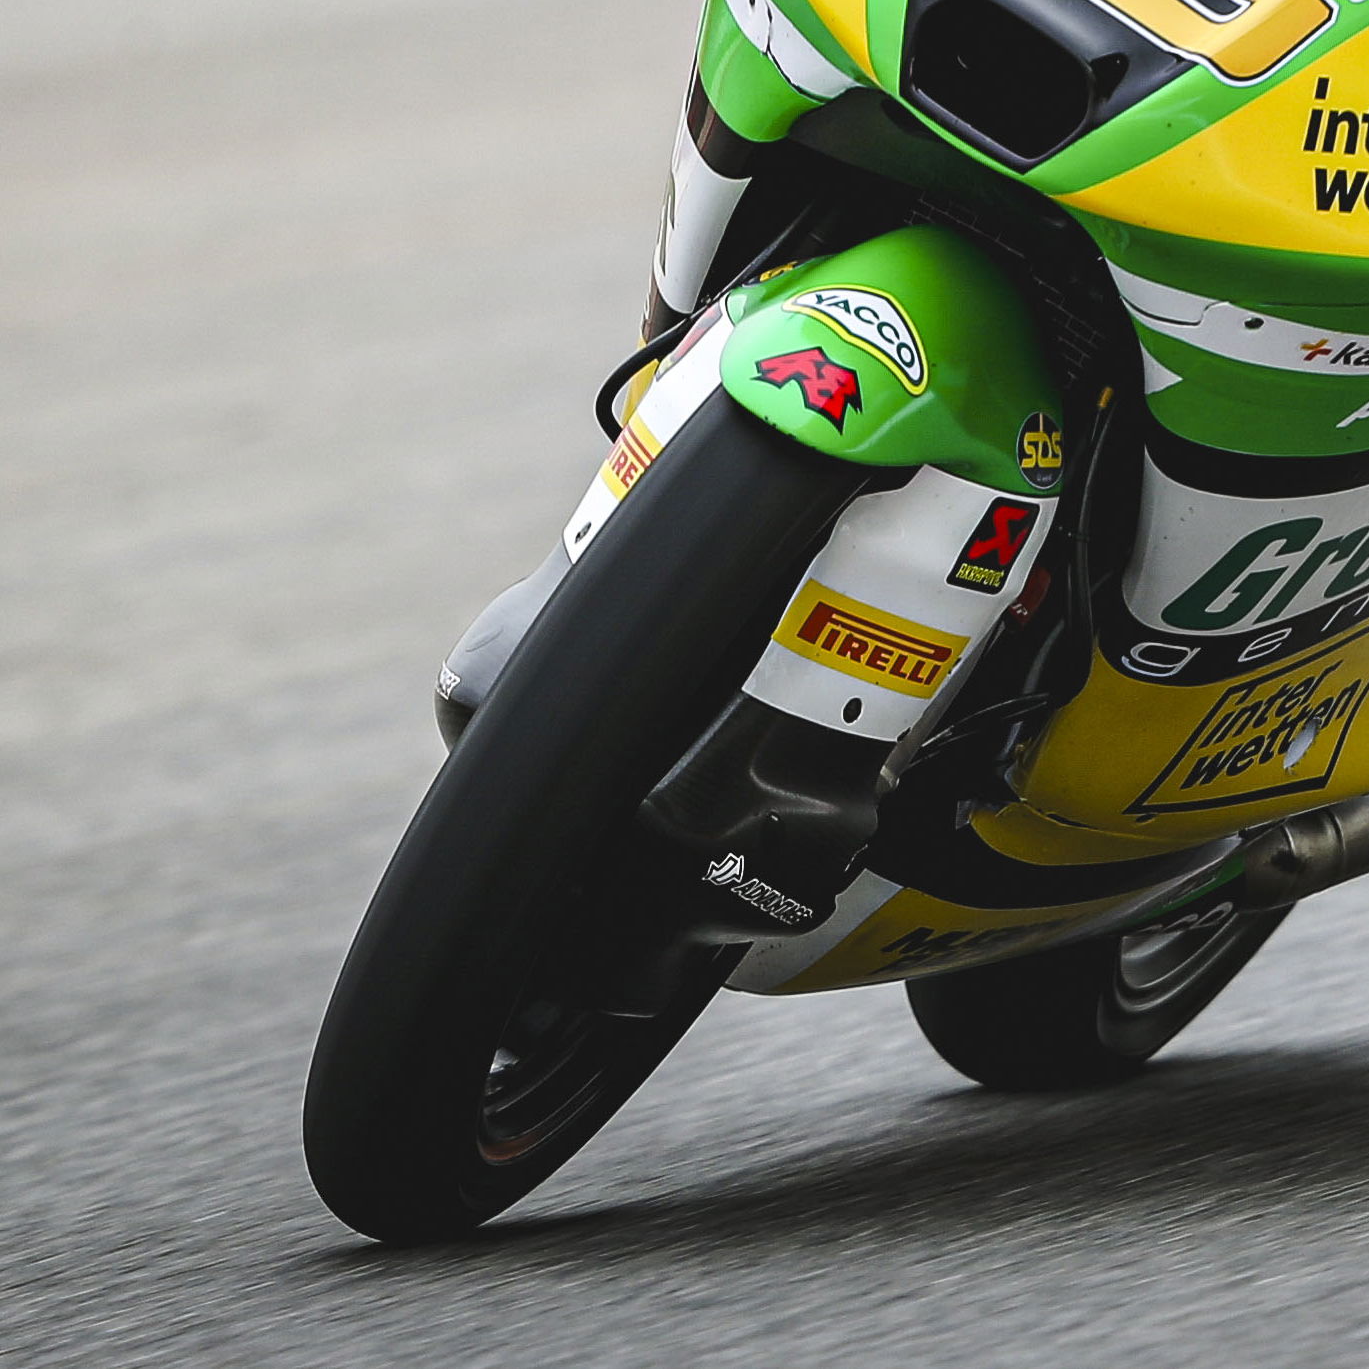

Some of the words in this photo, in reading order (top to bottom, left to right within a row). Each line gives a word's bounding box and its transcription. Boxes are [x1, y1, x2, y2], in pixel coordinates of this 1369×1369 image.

[814, 292, 917, 370] YACCO
[797, 600, 952, 686] PIRELLI
[1196, 658, 1345, 750] inter
